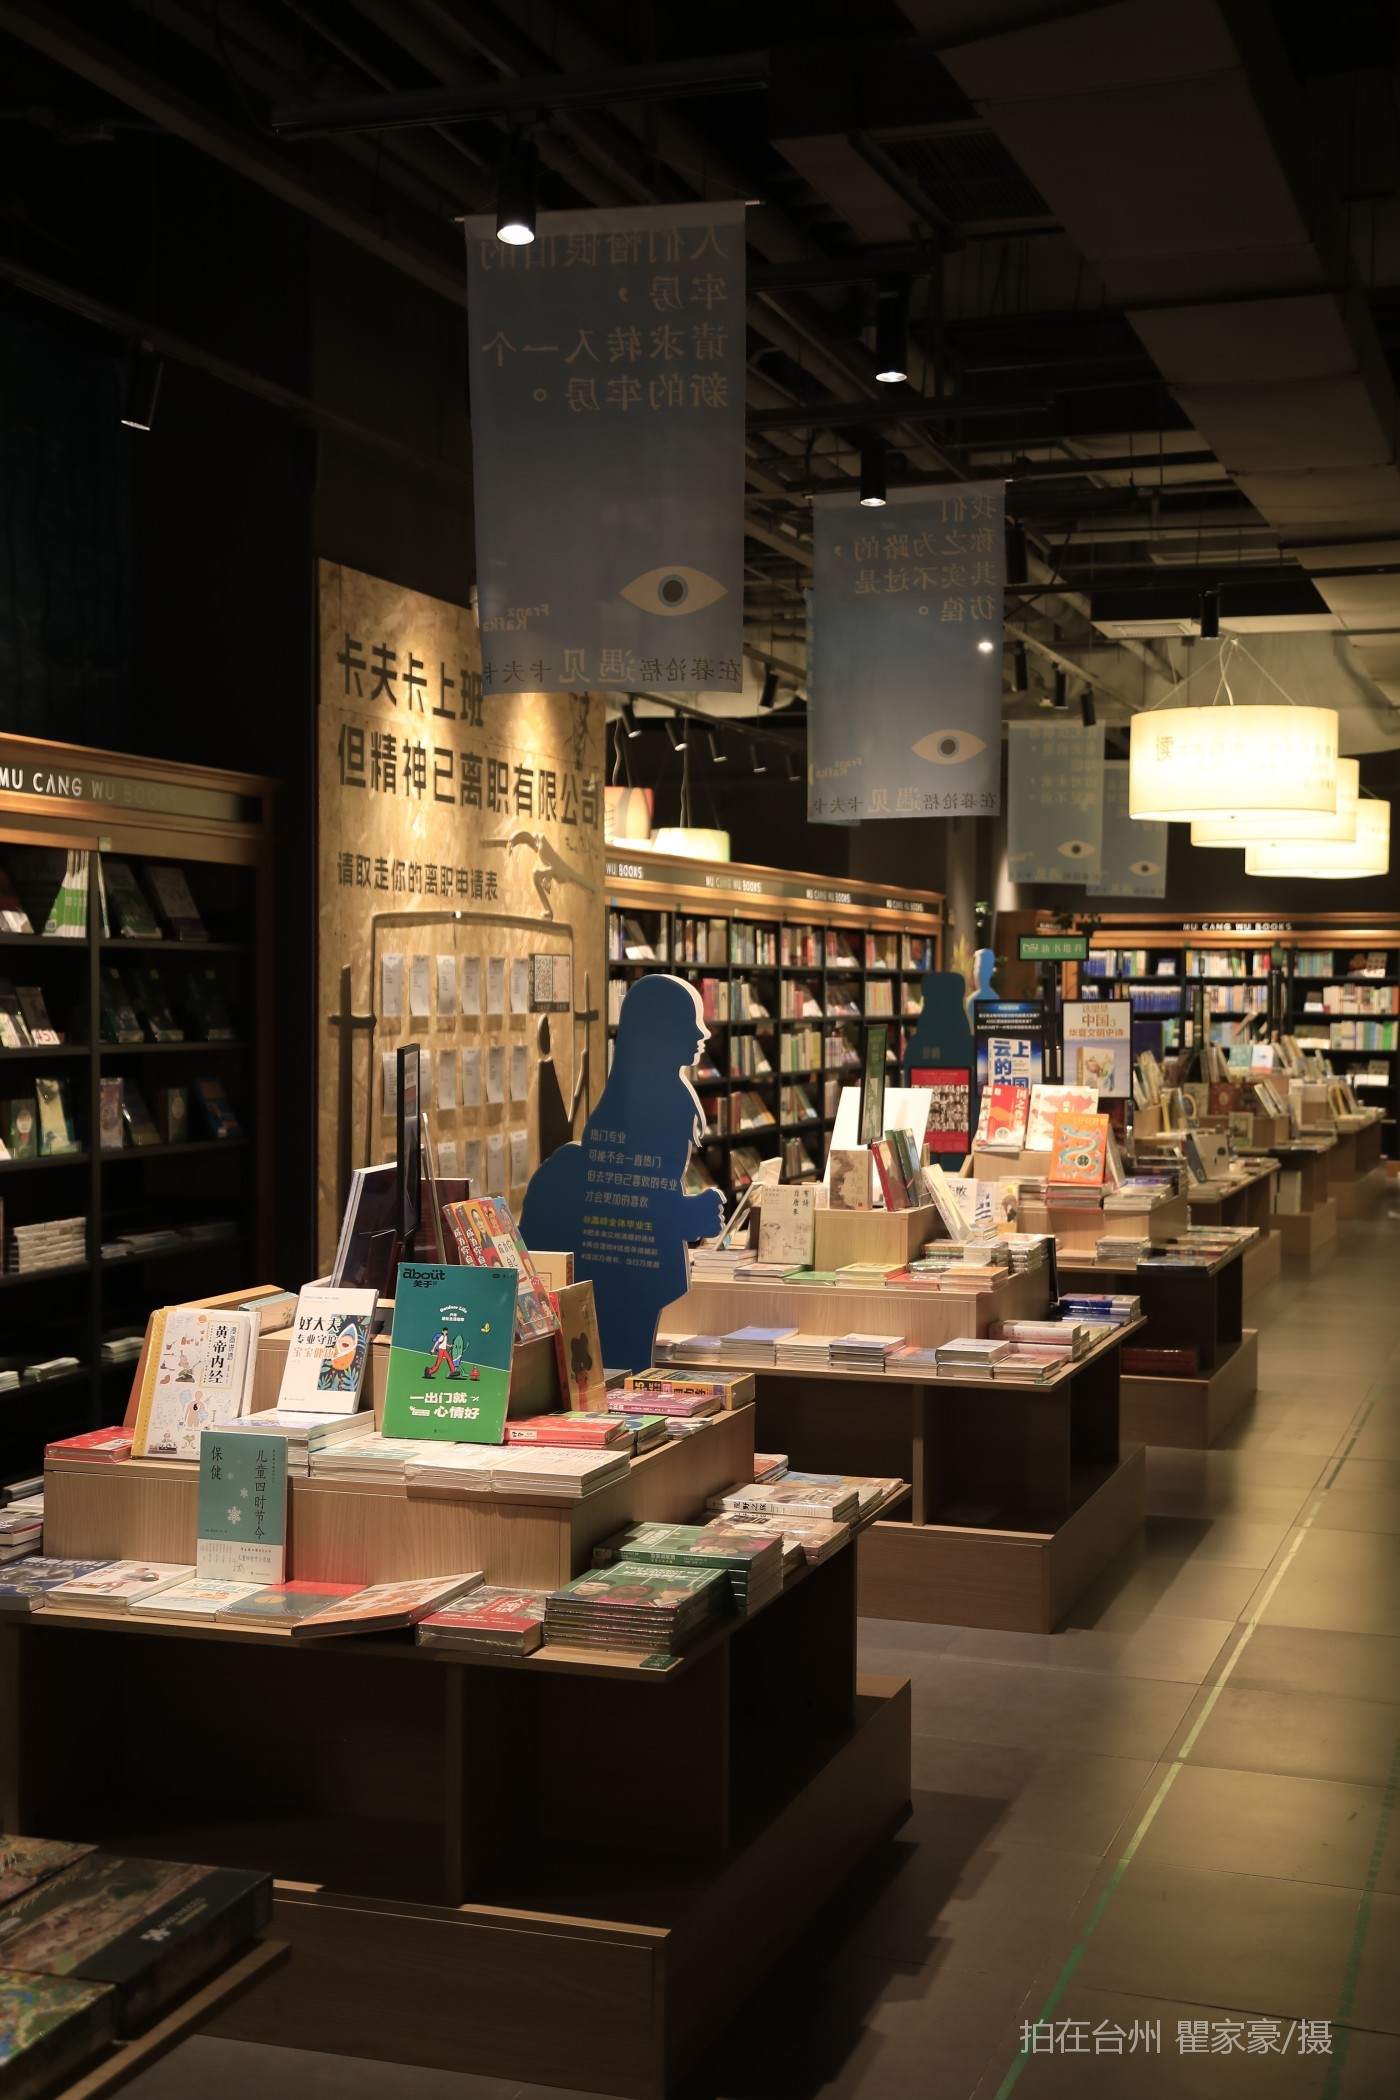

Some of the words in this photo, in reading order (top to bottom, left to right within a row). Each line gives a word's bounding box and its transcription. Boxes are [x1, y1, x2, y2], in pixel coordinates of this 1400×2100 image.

[0, 766, 24, 790] MU
[32, 772, 83, 797] CANG
[336, 850, 499, 902] 请取走你的离职申请表
[1202, 921, 1232, 931] CANG
[1236, 921, 1252, 931] WU
[1254, 922, 1293, 932] BOOKS
[208, 1325, 228, 1384] 黄帝内经
[409, 1391, 468, 1404] 一出门就
[433, 1405, 480, 1420] 心情好
[210, 1445, 224, 1481] 保健
[253, 1449, 268, 1541] 儿童四时节令
